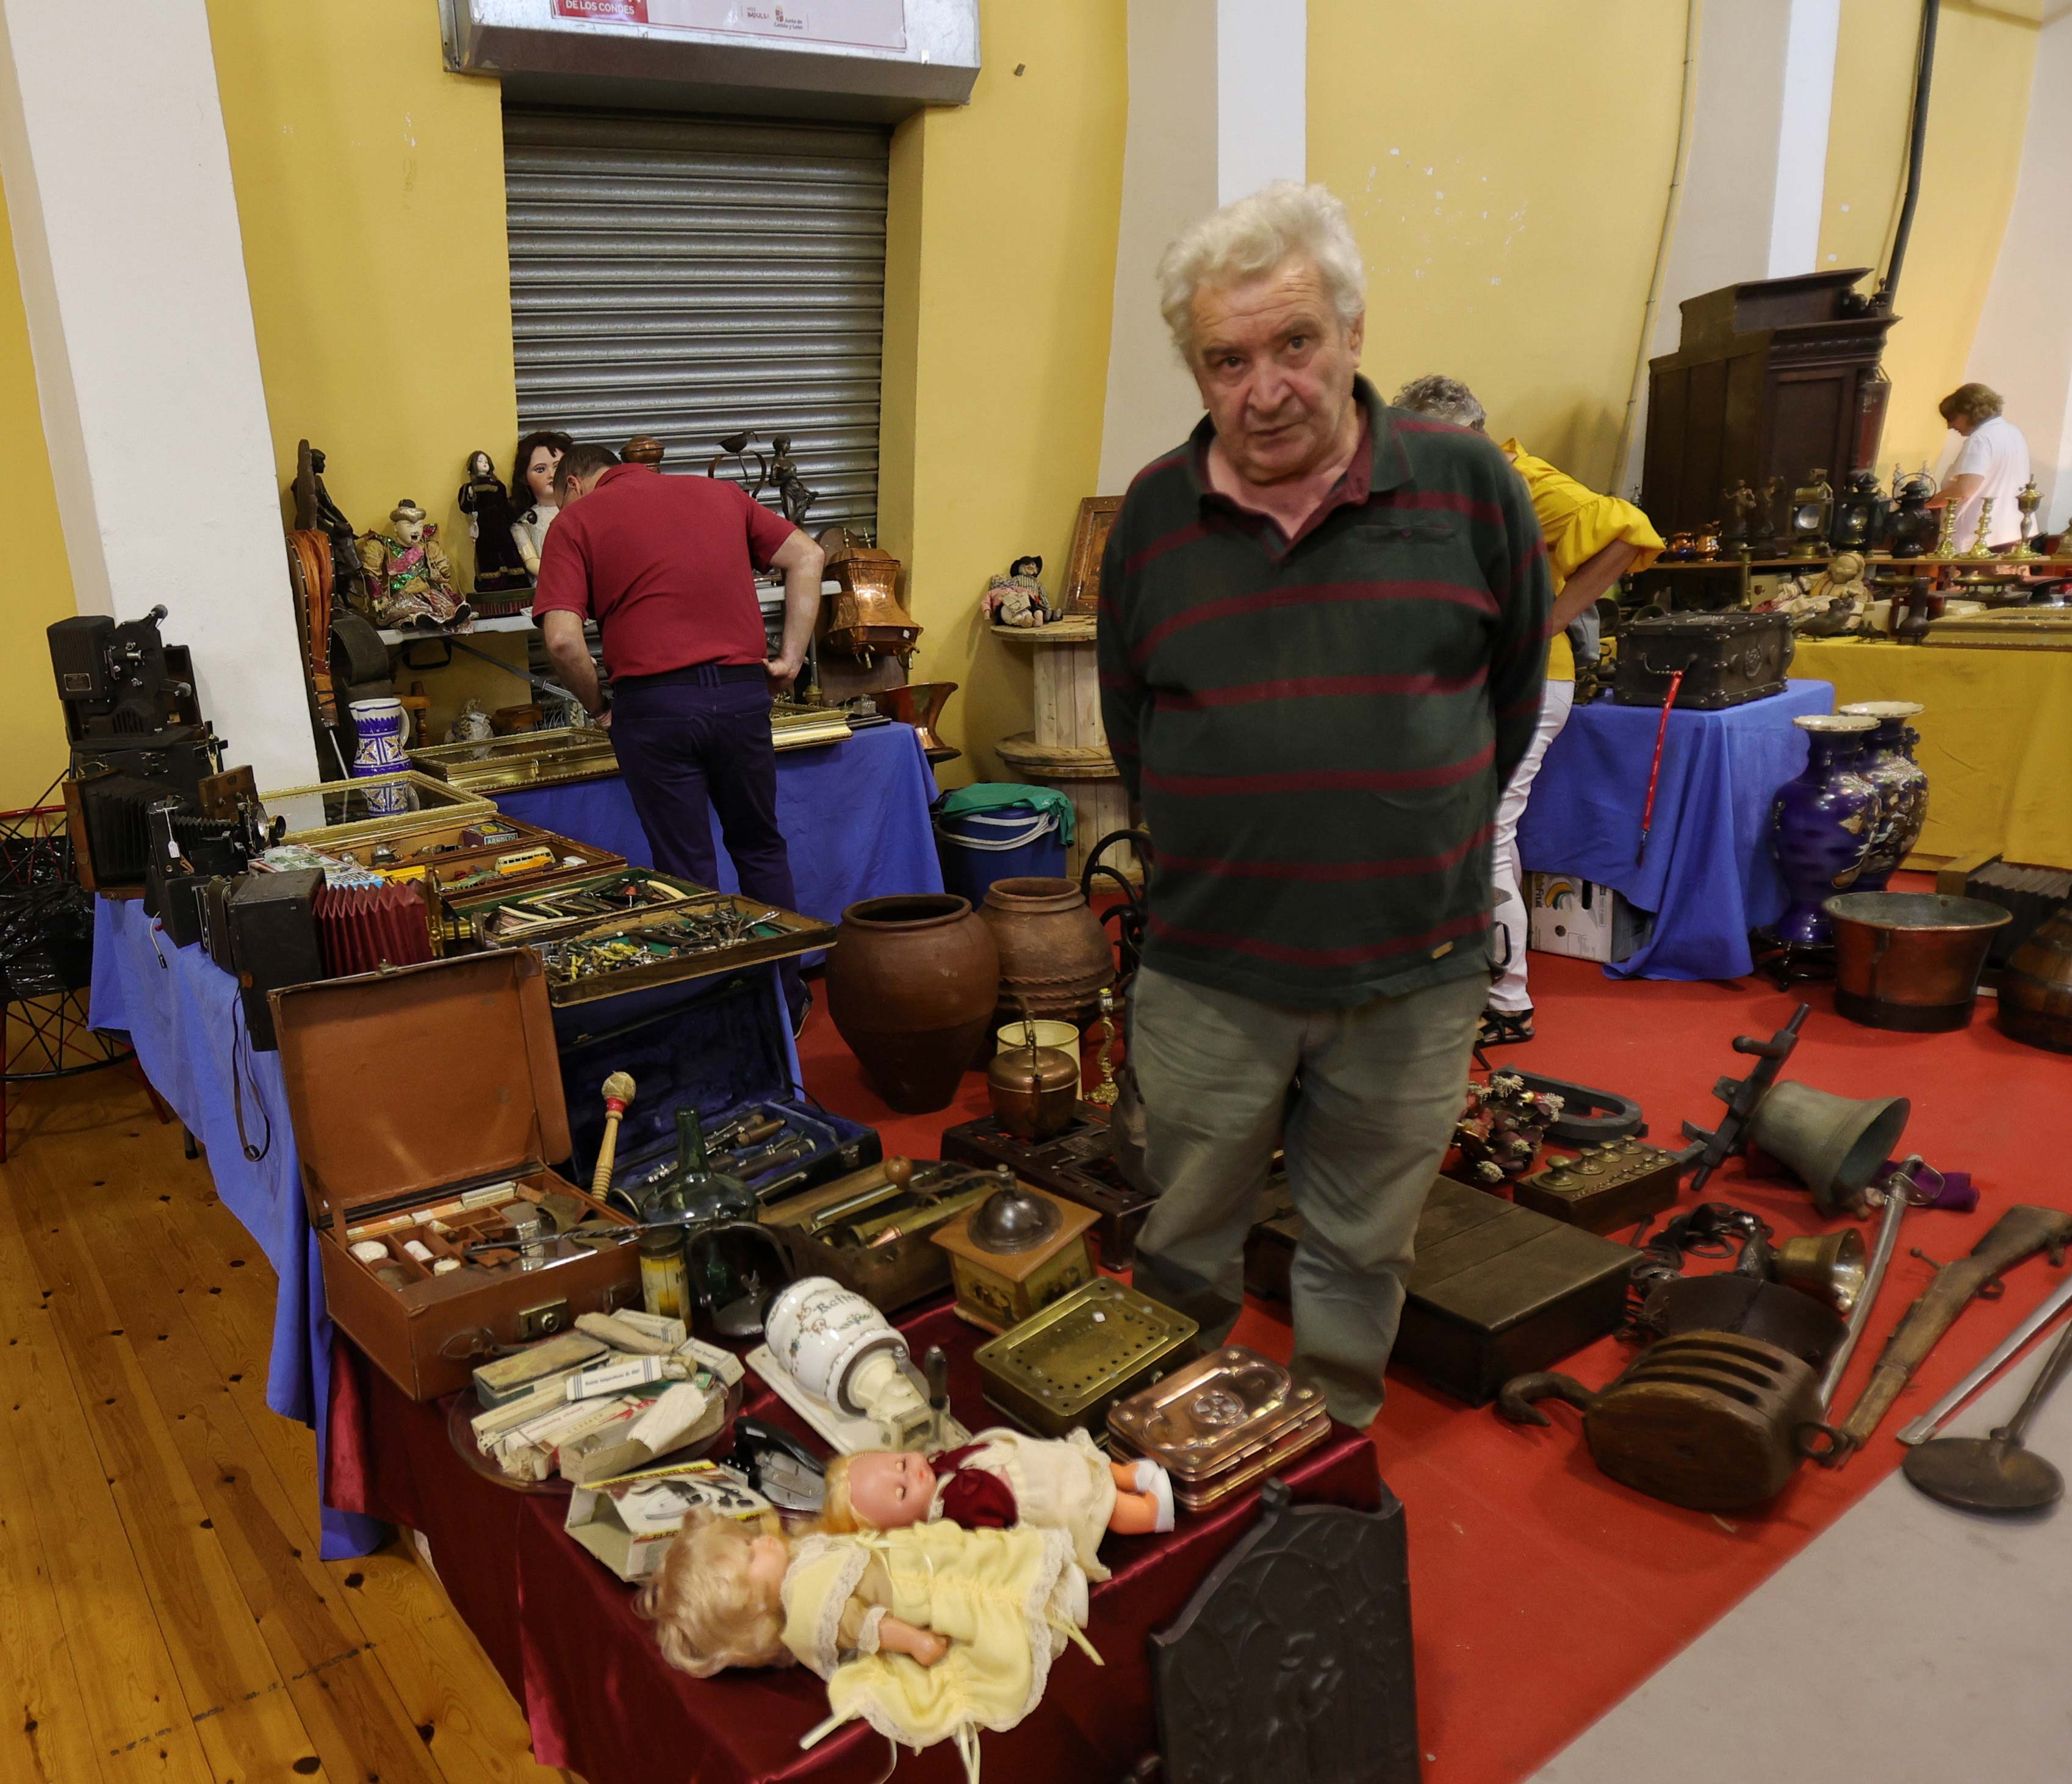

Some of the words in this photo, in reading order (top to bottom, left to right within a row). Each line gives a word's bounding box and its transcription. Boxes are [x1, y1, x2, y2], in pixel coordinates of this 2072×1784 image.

[566, 0, 578, 9] DE
[580, 2, 597, 11] LOS
[599, 3, 635, 15] CONDES
